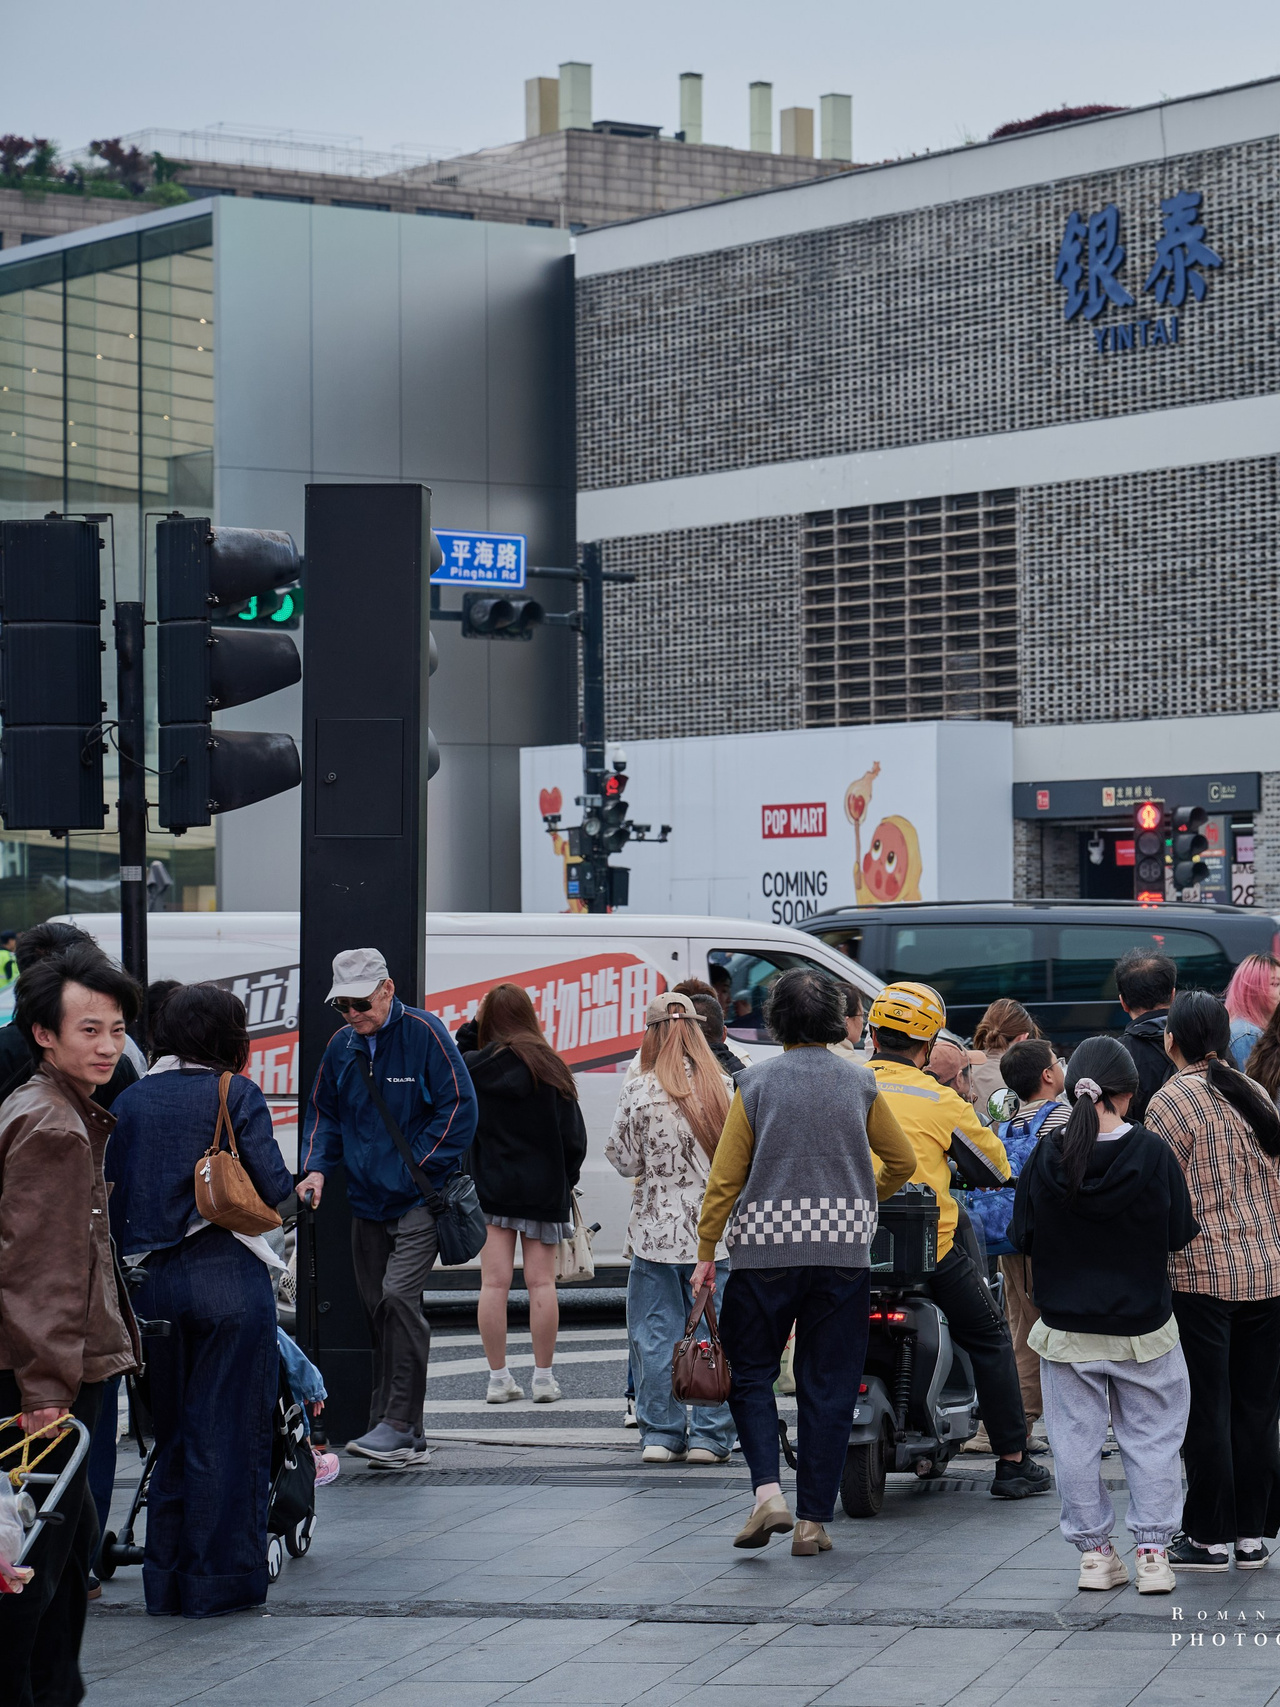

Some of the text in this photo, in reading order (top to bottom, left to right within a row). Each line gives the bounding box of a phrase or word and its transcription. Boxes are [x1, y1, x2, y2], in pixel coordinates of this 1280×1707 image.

[1055, 190, 1222, 320] 银泰
[1093, 316, 1178, 353] YINTAI
[450, 539, 518, 570] 平海路
[449, 566, 517, 581] Pinghai Rd
[1210, 785, 1220, 800] C
[763, 806, 825, 836] POP MART
[762, 870, 828, 898] COMING
[772, 899, 818, 925] SOON
